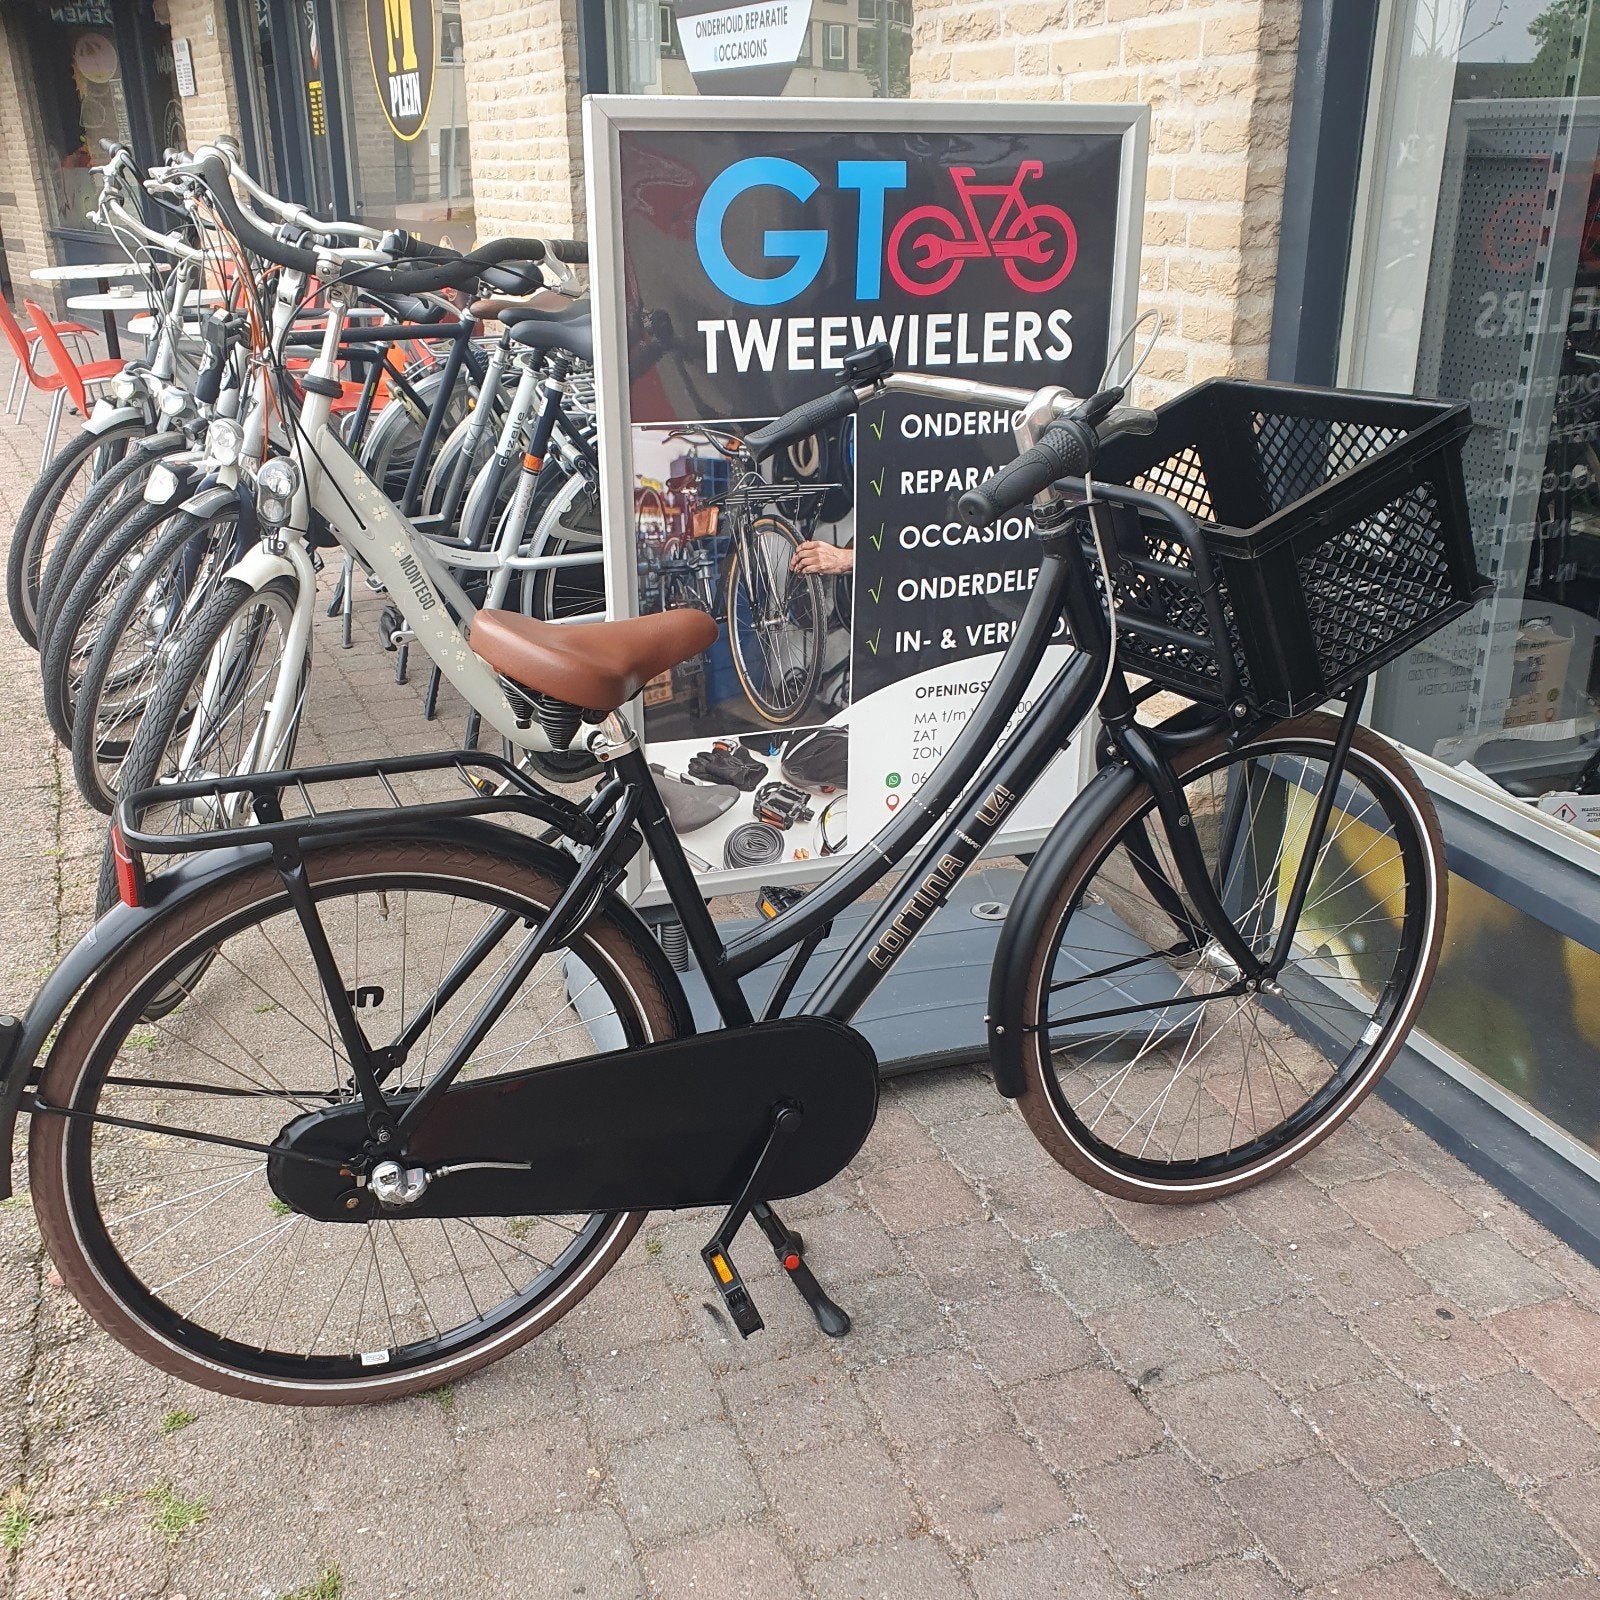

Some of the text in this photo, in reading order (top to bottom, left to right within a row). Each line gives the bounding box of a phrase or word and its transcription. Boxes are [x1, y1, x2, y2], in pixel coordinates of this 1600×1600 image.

[388, 72, 422, 118] PLEIN
[695, 156, 907, 305] GT
[697, 308, 1073, 374] TWEEWIELERS
[499, 411, 526, 468] Gazelle
[900, 409, 1027, 439] ONDERHO
[900, 465, 1006, 495] REPARA
[898, 516, 1037, 550] OCCASION
[398, 554, 436, 611] MONTEGO
[897, 567, 1040, 602] ONDERDELE
[895, 630, 931, 653] IN-
[940, 628, 957, 650] &
[913, 712, 938, 725] MA
[941, 709, 966, 724] t/m
[912, 746, 943, 760] ZON
[913, 729, 938, 743] ZAT
[868, 853, 965, 970] CORTINA
